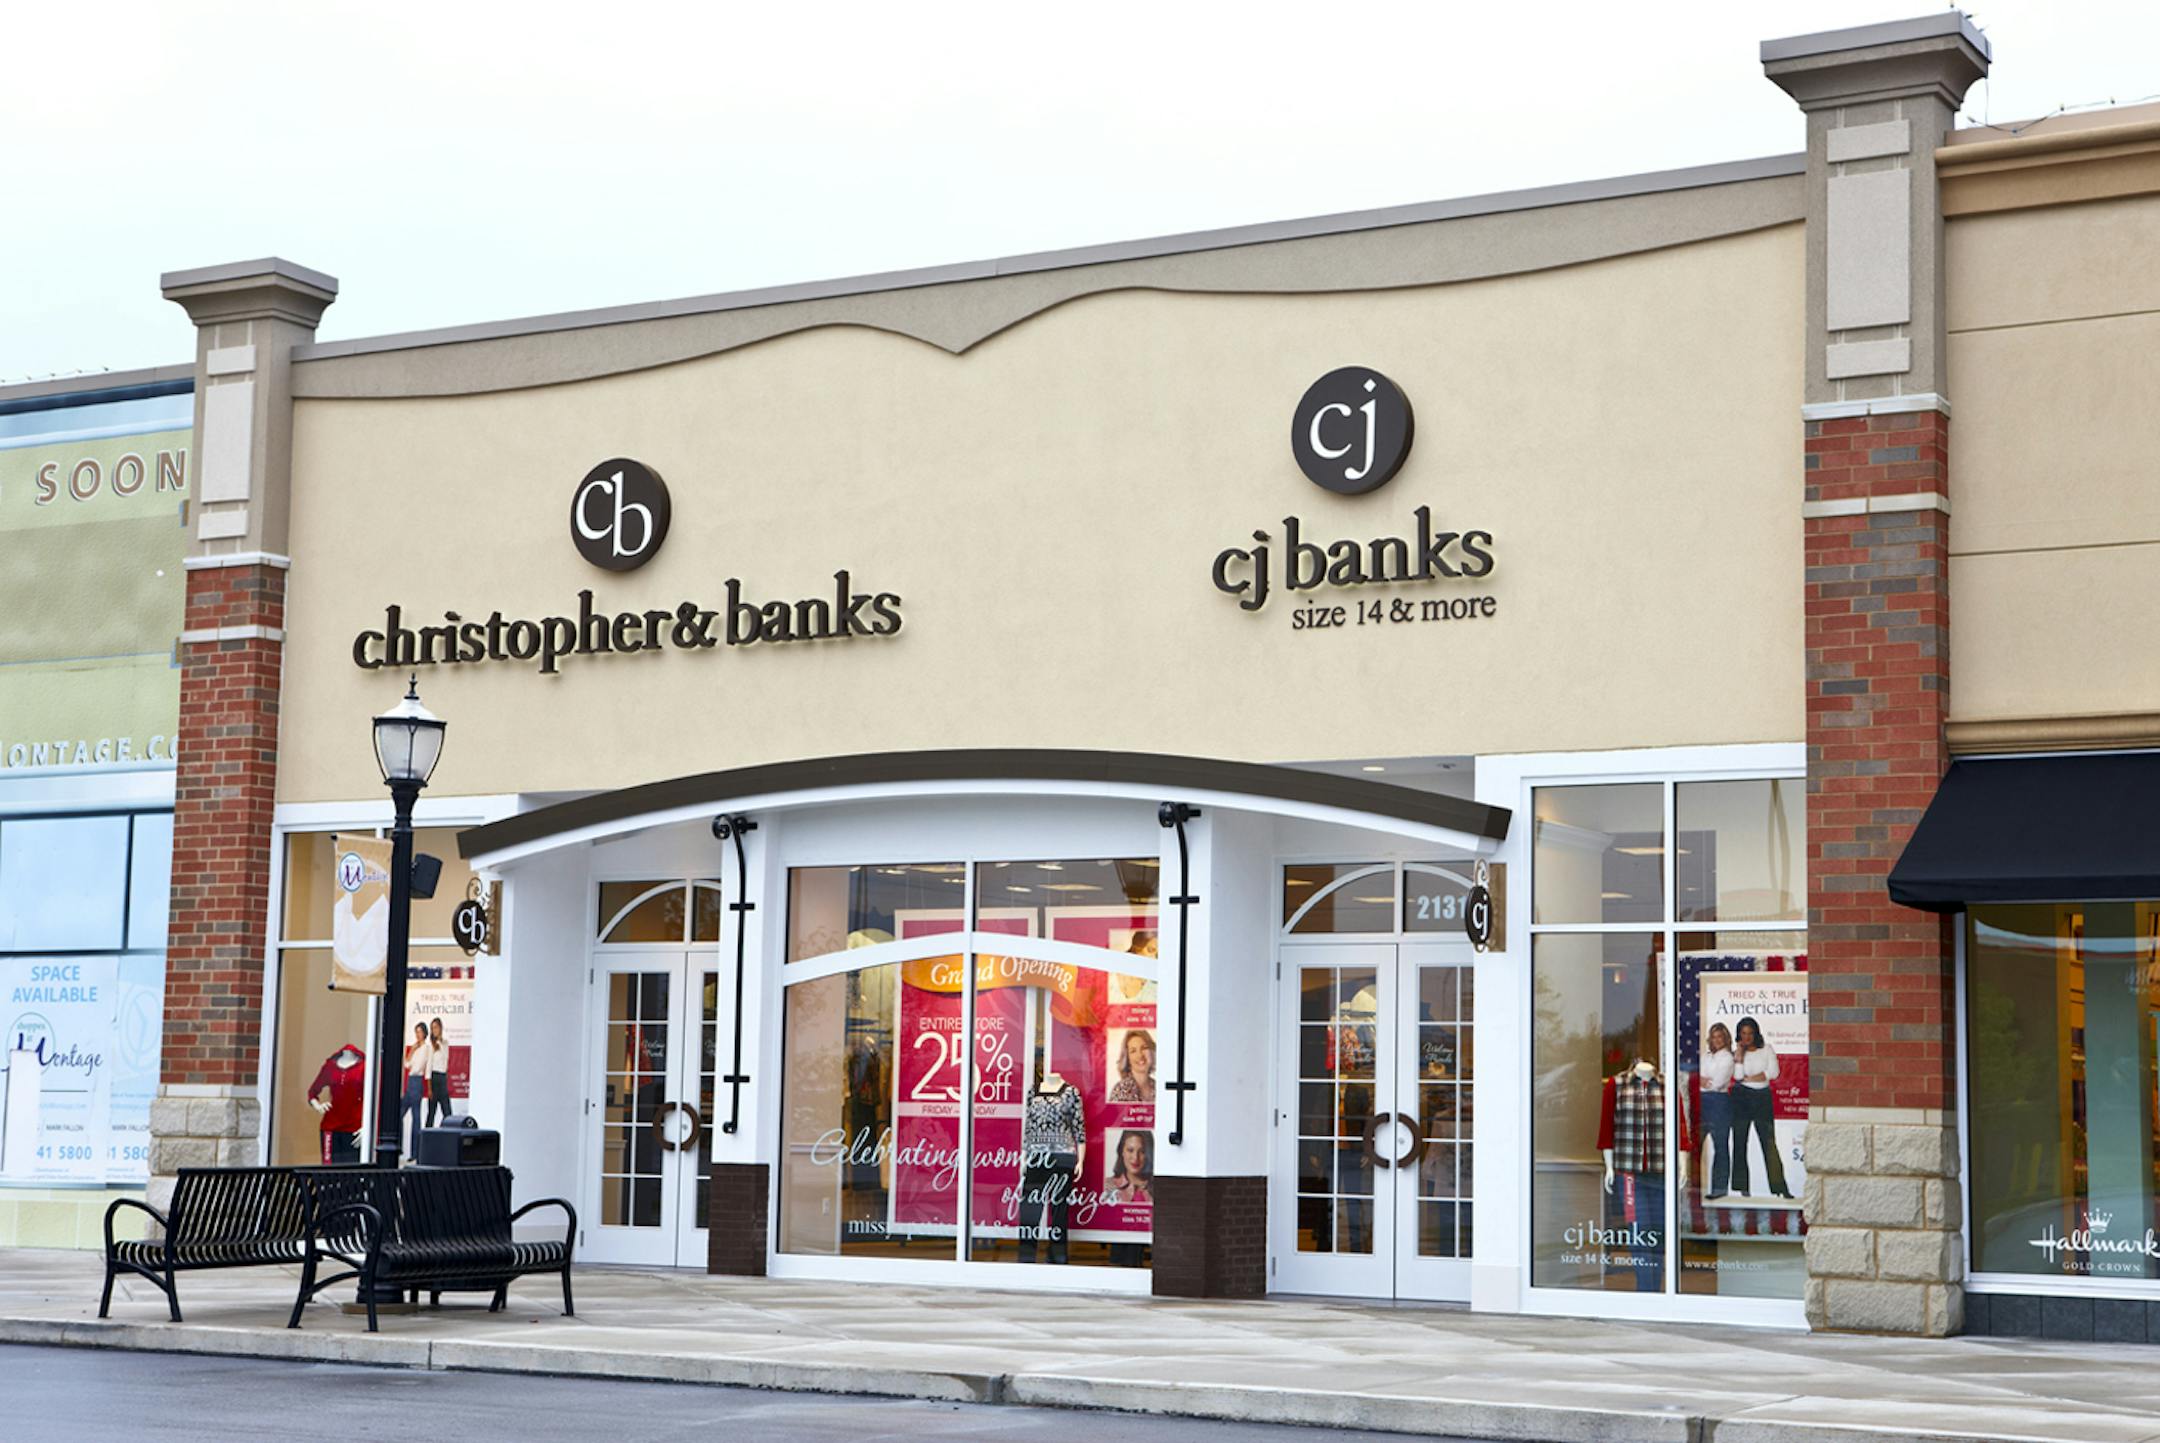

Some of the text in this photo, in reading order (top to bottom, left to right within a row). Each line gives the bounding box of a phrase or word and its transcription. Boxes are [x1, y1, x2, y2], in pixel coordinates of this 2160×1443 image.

[1308, 379, 1377, 480] cj
[36, 448, 188, 505] SOON
[574, 471, 653, 557] cb
[1212, 505, 1494, 611] cj banks
[353, 569, 902, 673] christopher & banks
[1292, 595, 1497, 629] size 14 & more
[0, 735, 178, 768] ONTAGE.C
[1417, 895, 1468, 919] 2131
[1472, 894, 1489, 940] cj
[458, 906, 486, 945] cb
[31, 965, 80, 981] SPACE
[1000, 955, 1073, 992] Opening
[12, 986, 98, 1003] AVAILABLE
[412, 1001, 465, 1014] American
[1716, 999, 1796, 1015] American
[1728, 990, 1797, 999] TRIED & TRUE
[919, 1017, 1004, 1030] ENTIRE TORE
[979, 1072, 1013, 1101] off
[922, 1105, 953, 1115] FRIDAY
[59, 1147, 93, 1160] 5800
[811, 1127, 1056, 1191] Celebrating women
[1002, 1173, 1124, 1225] of all sizes
[1563, 1220, 1658, 1250] cj banks
[2028, 1223, 2160, 1263] Hallmark
[1560, 1253, 1582, 1264] size
[1585, 1253, 1597, 1264] 14
[1600, 1254, 1612, 1265] &
[2063, 1261, 2142, 1273] GOLD CROWN
